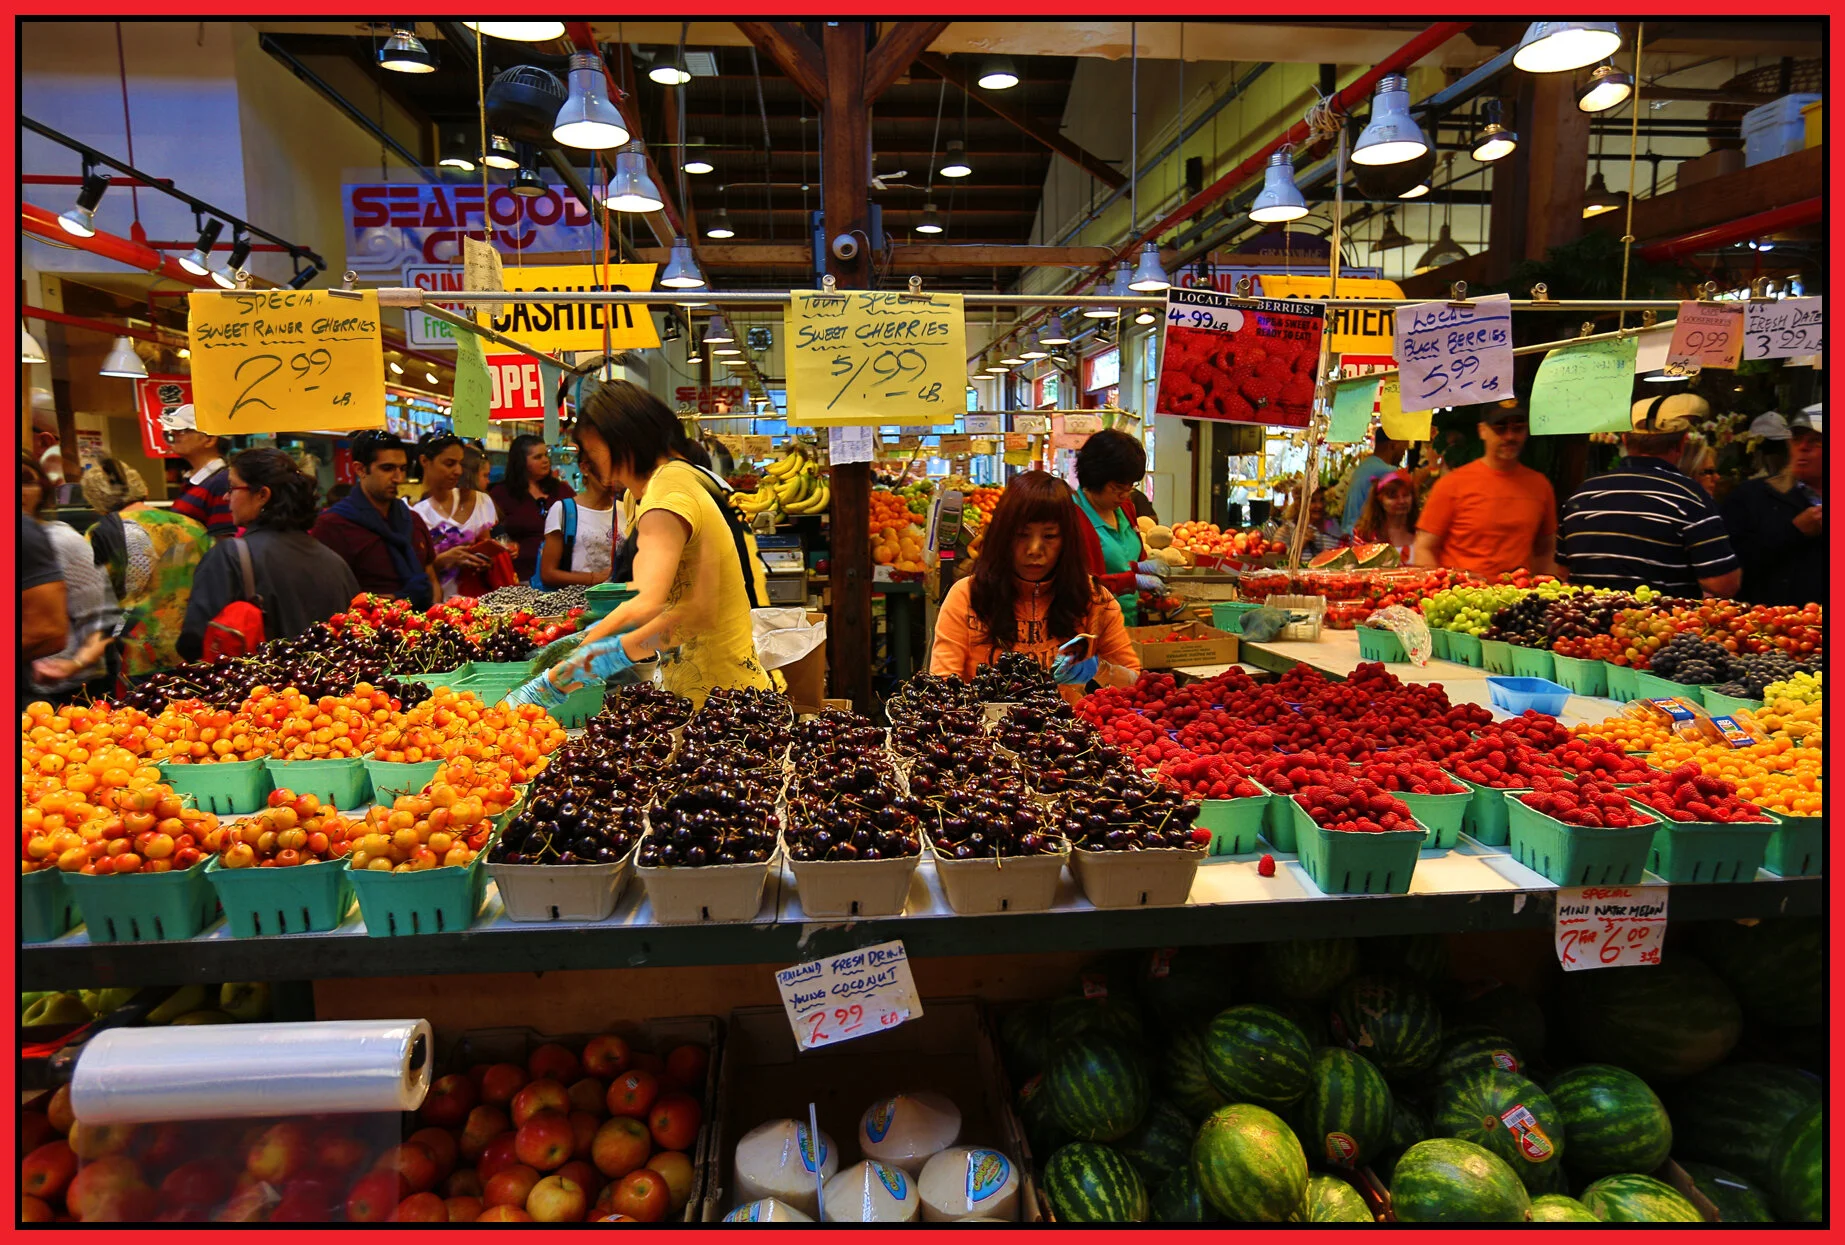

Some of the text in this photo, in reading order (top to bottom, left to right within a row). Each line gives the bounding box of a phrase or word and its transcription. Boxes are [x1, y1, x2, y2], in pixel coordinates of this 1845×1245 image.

[352, 186, 591, 228] SEAFOOD
[1179, 292, 1223, 306] LOCAL
[1168, 307, 1214, 329] 4.99
[1413, 308, 1475, 329] LOCAL
[1750, 315, 1788, 333] FRESH
[197, 323, 249, 342] SWEET
[253, 319, 303, 338] RAINER
[796, 319, 949, 349] SWEET CHERRIES
[1447, 329, 1507, 353] BERRIES
[675, 385, 744, 401] SEAFOO
[1559, 904, 1590, 916] MINI
[1627, 901, 1665, 918] MELON
[777, 945, 906, 985] THAILAND FRESH DRINK
[788, 965, 898, 1010] YOUNG COCONUT
[880, 1011, 900, 1026] EA
